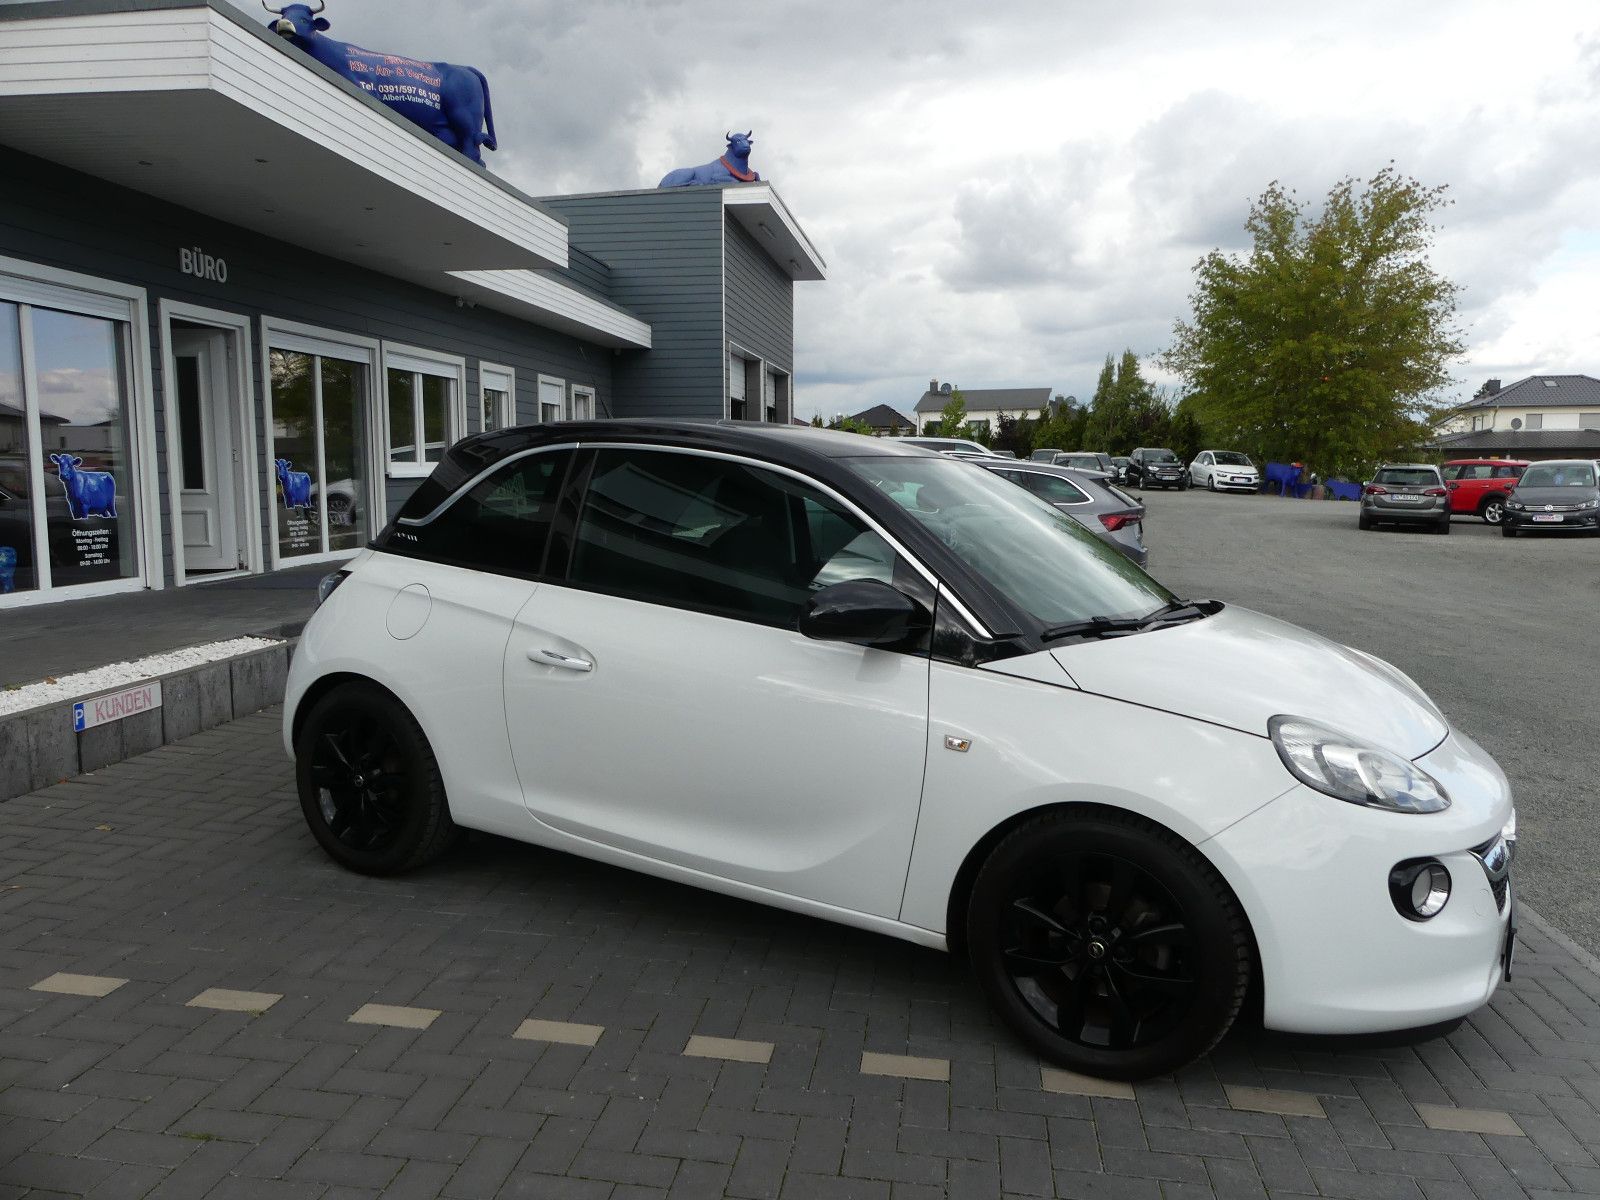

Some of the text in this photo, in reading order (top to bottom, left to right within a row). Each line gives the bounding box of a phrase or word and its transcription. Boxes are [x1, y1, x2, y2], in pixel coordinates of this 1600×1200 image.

[359, 81, 377, 91] Tel.
[378, 85, 416, 94] 0391/597
[428, 92, 440, 102] 100
[179, 246, 227, 283] BÜRO
[75, 688, 152, 725] P KUNDEN
